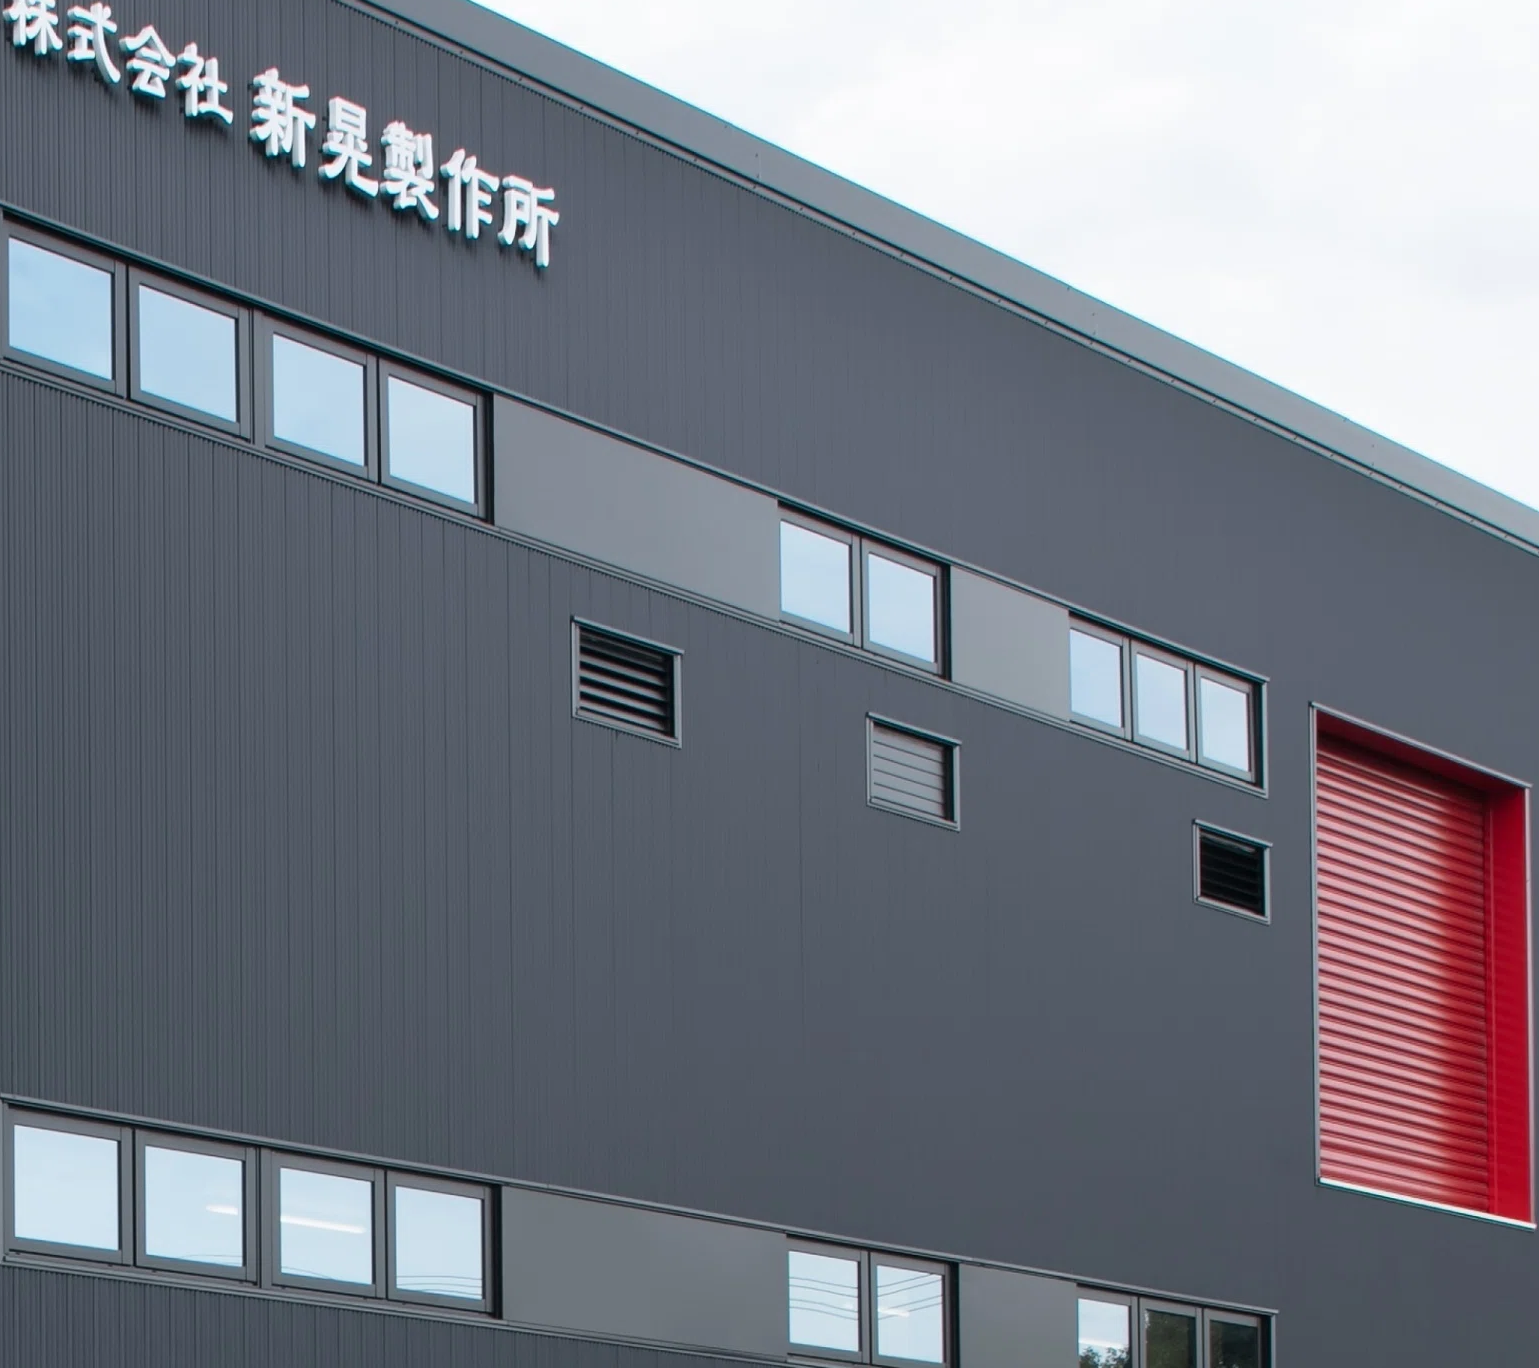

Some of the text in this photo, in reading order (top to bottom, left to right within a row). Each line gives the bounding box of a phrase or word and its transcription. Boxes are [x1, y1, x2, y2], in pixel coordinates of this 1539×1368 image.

[249, 67, 561, 268] 新晃製作所
